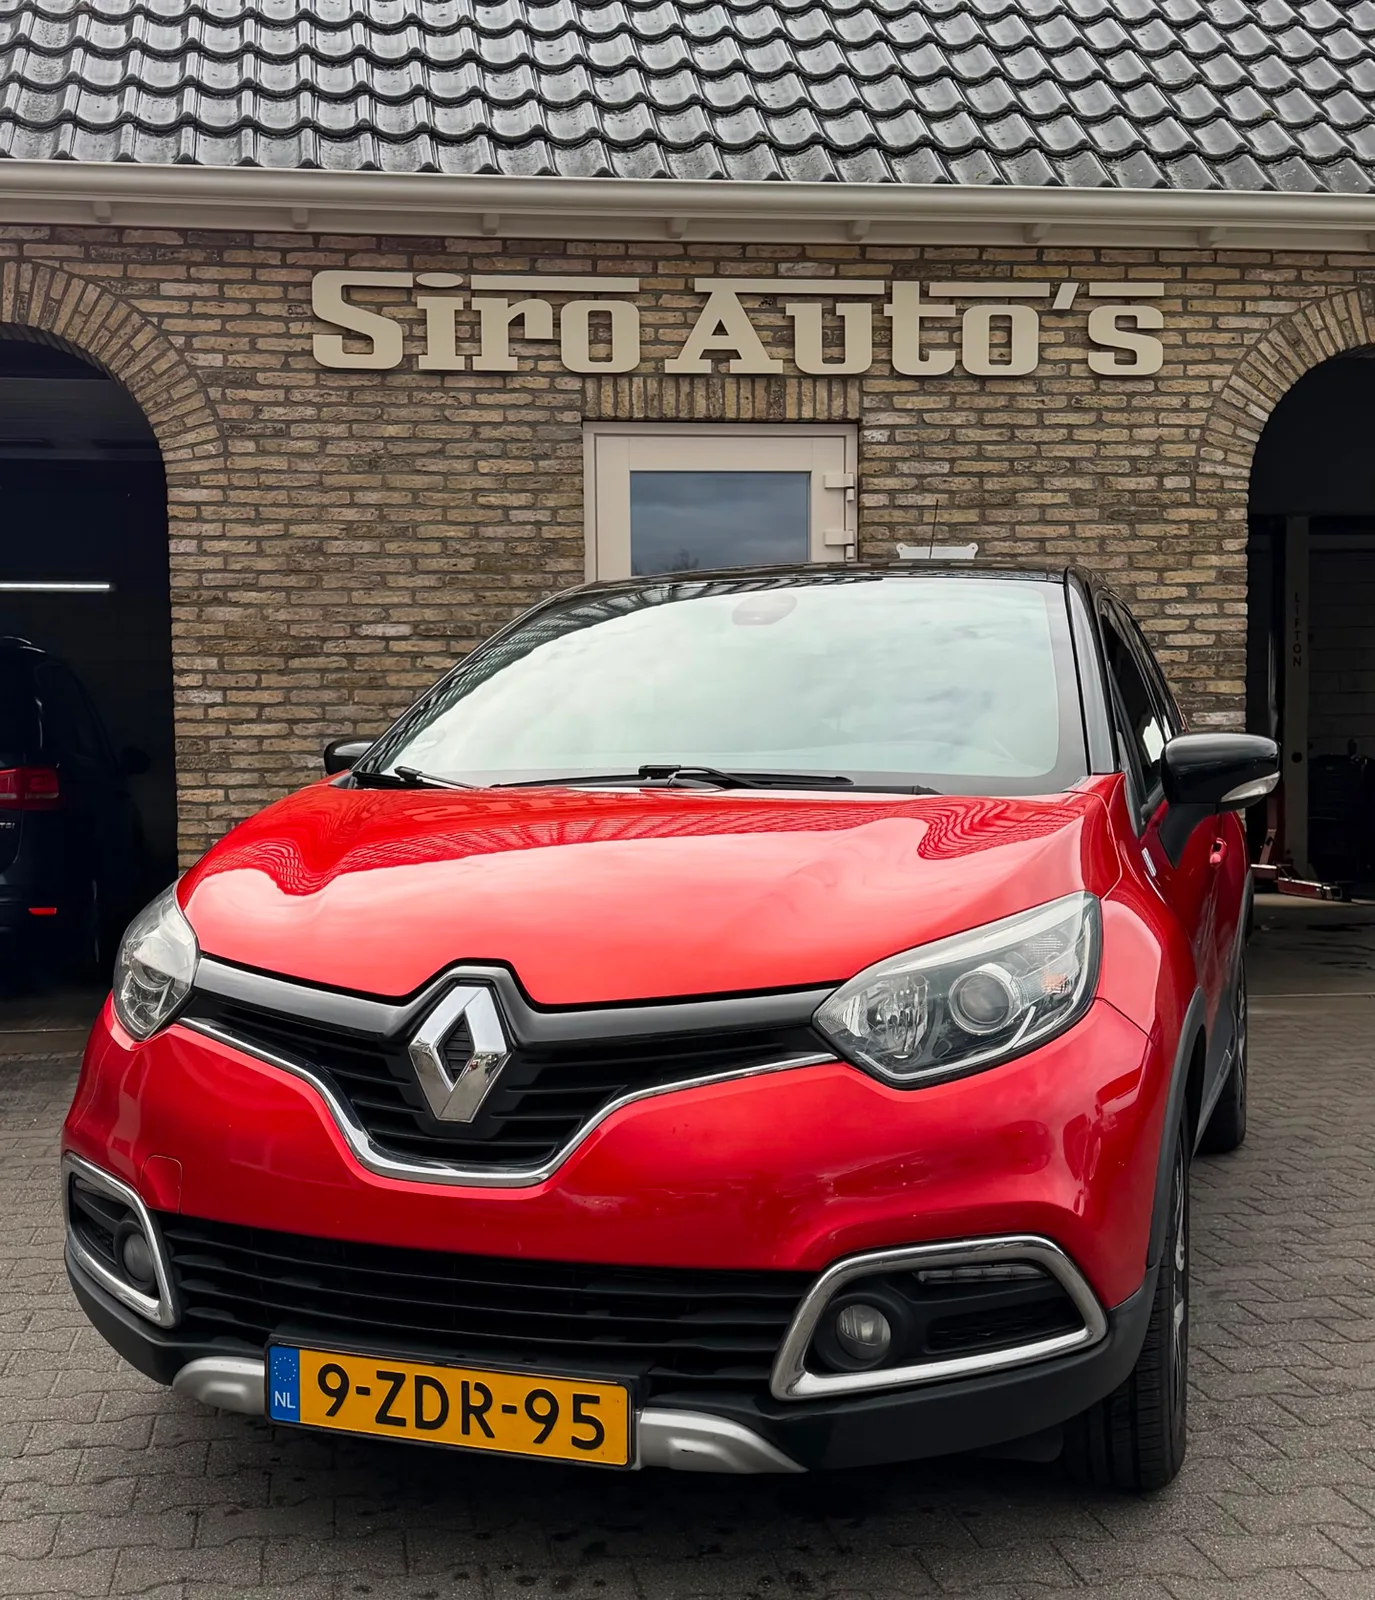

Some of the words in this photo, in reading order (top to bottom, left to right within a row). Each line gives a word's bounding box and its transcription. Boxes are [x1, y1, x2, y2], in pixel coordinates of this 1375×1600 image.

[311, 269, 641, 375] Siro
[664, 277, 1165, 377] Auto's
[1292, 591, 1302, 667] LIFTON
[274, 1391, 296, 1409] NL
[317, 1363, 605, 1450] 9-ZDR-95
